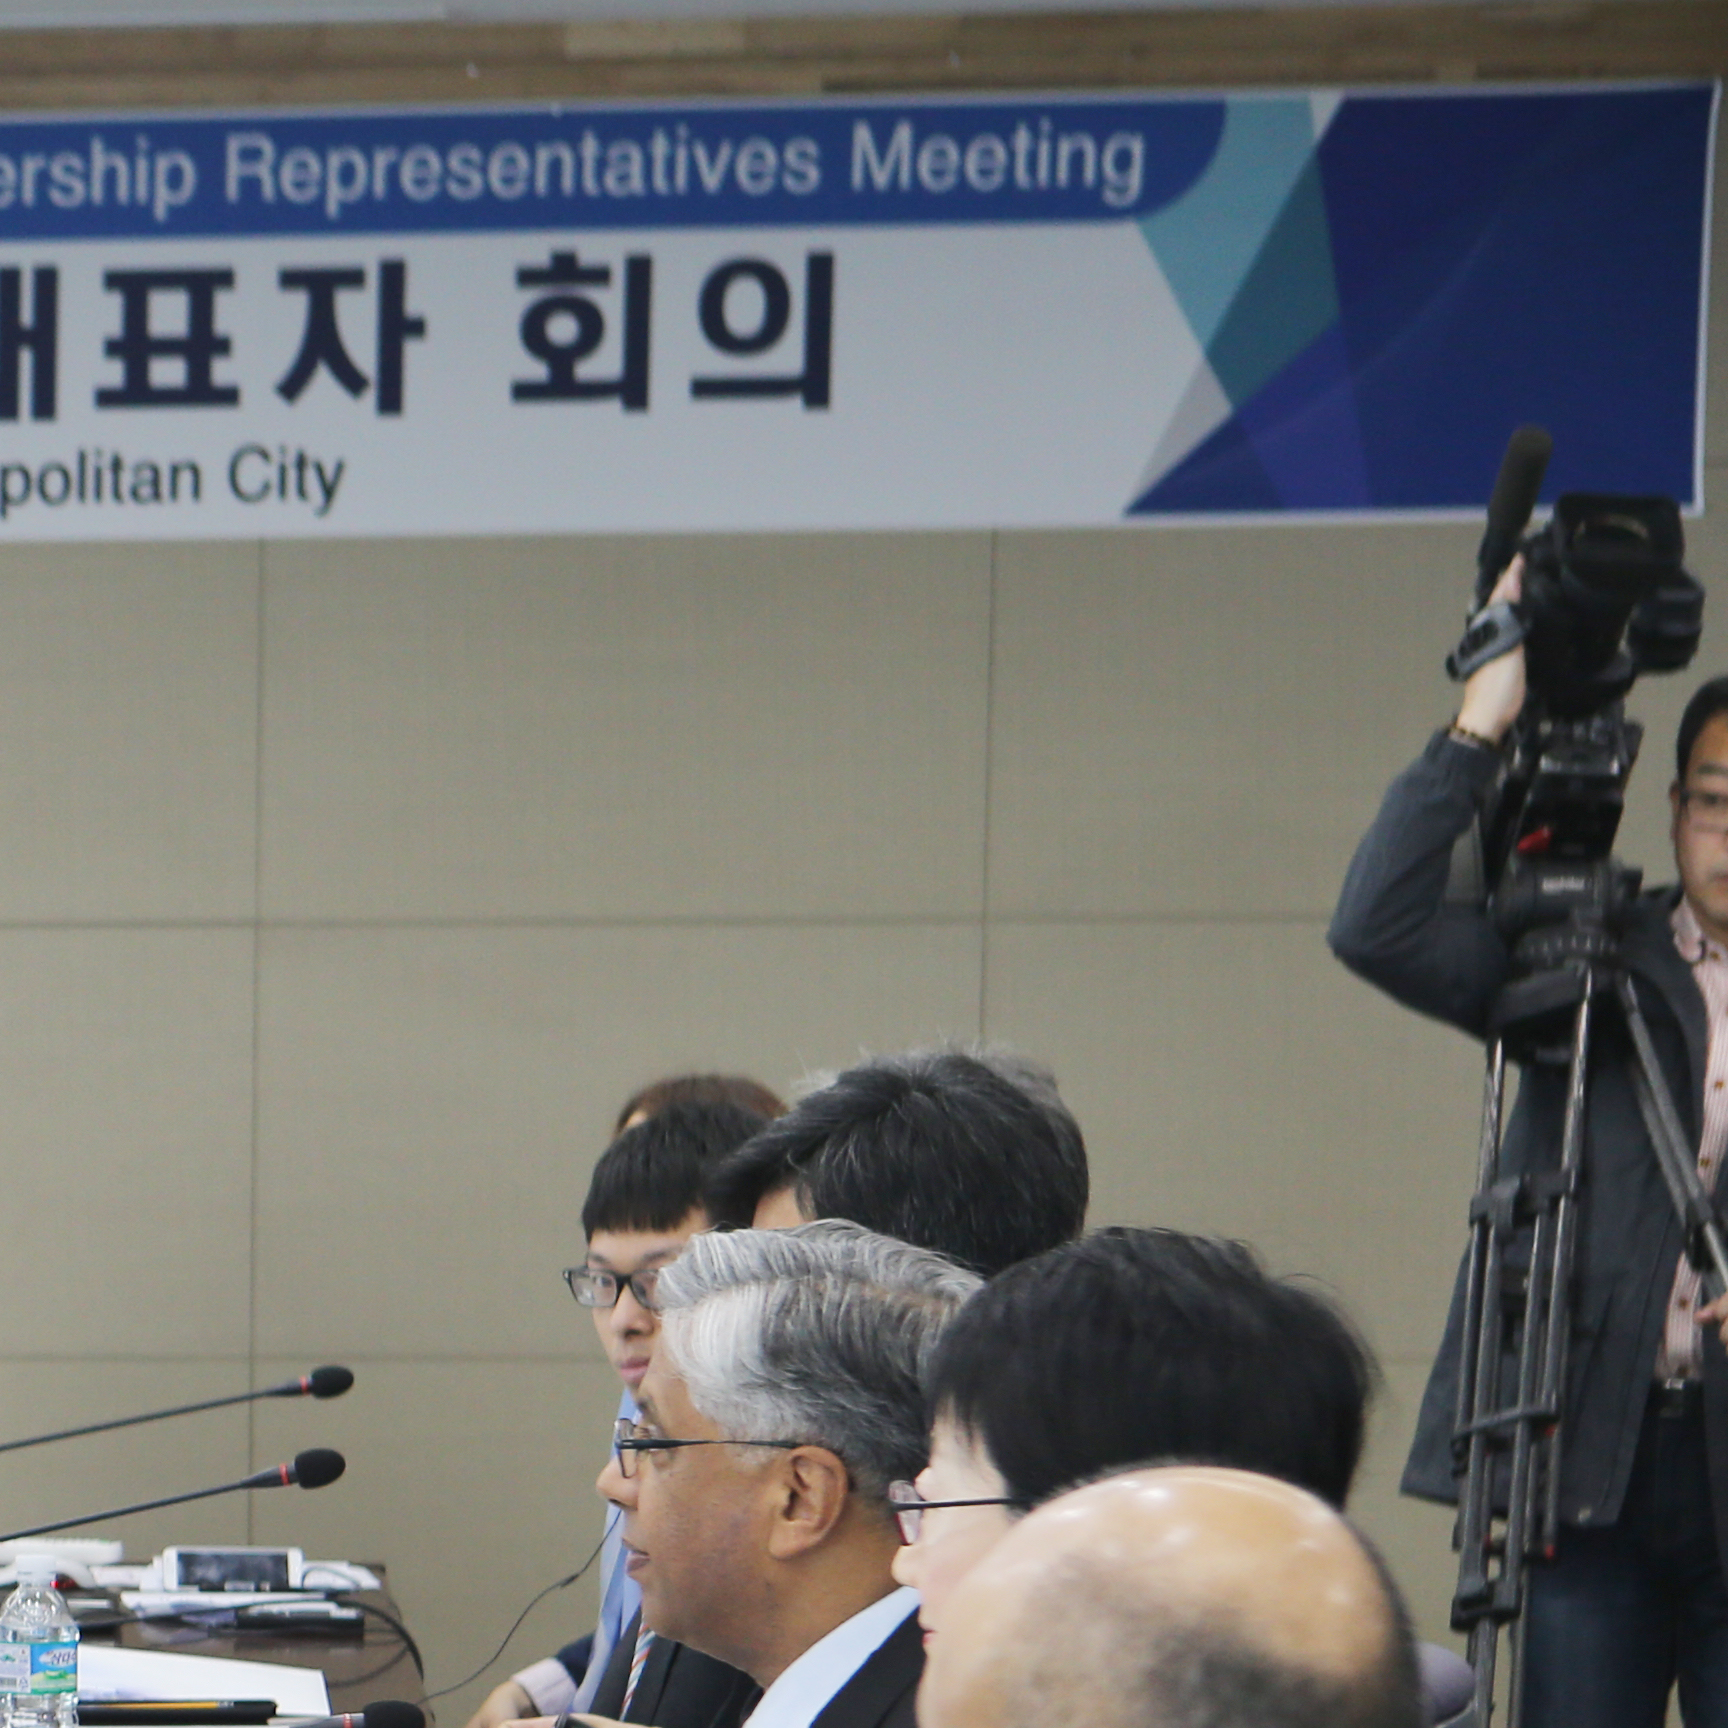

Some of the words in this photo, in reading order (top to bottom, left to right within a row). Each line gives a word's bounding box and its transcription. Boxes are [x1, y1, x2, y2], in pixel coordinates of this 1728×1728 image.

[224, 133, 821, 214] Representatives
[851, 122, 1146, 200] Meeting
[507, 245, 838, 412] 회의
[224, 441, 350, 521] City
